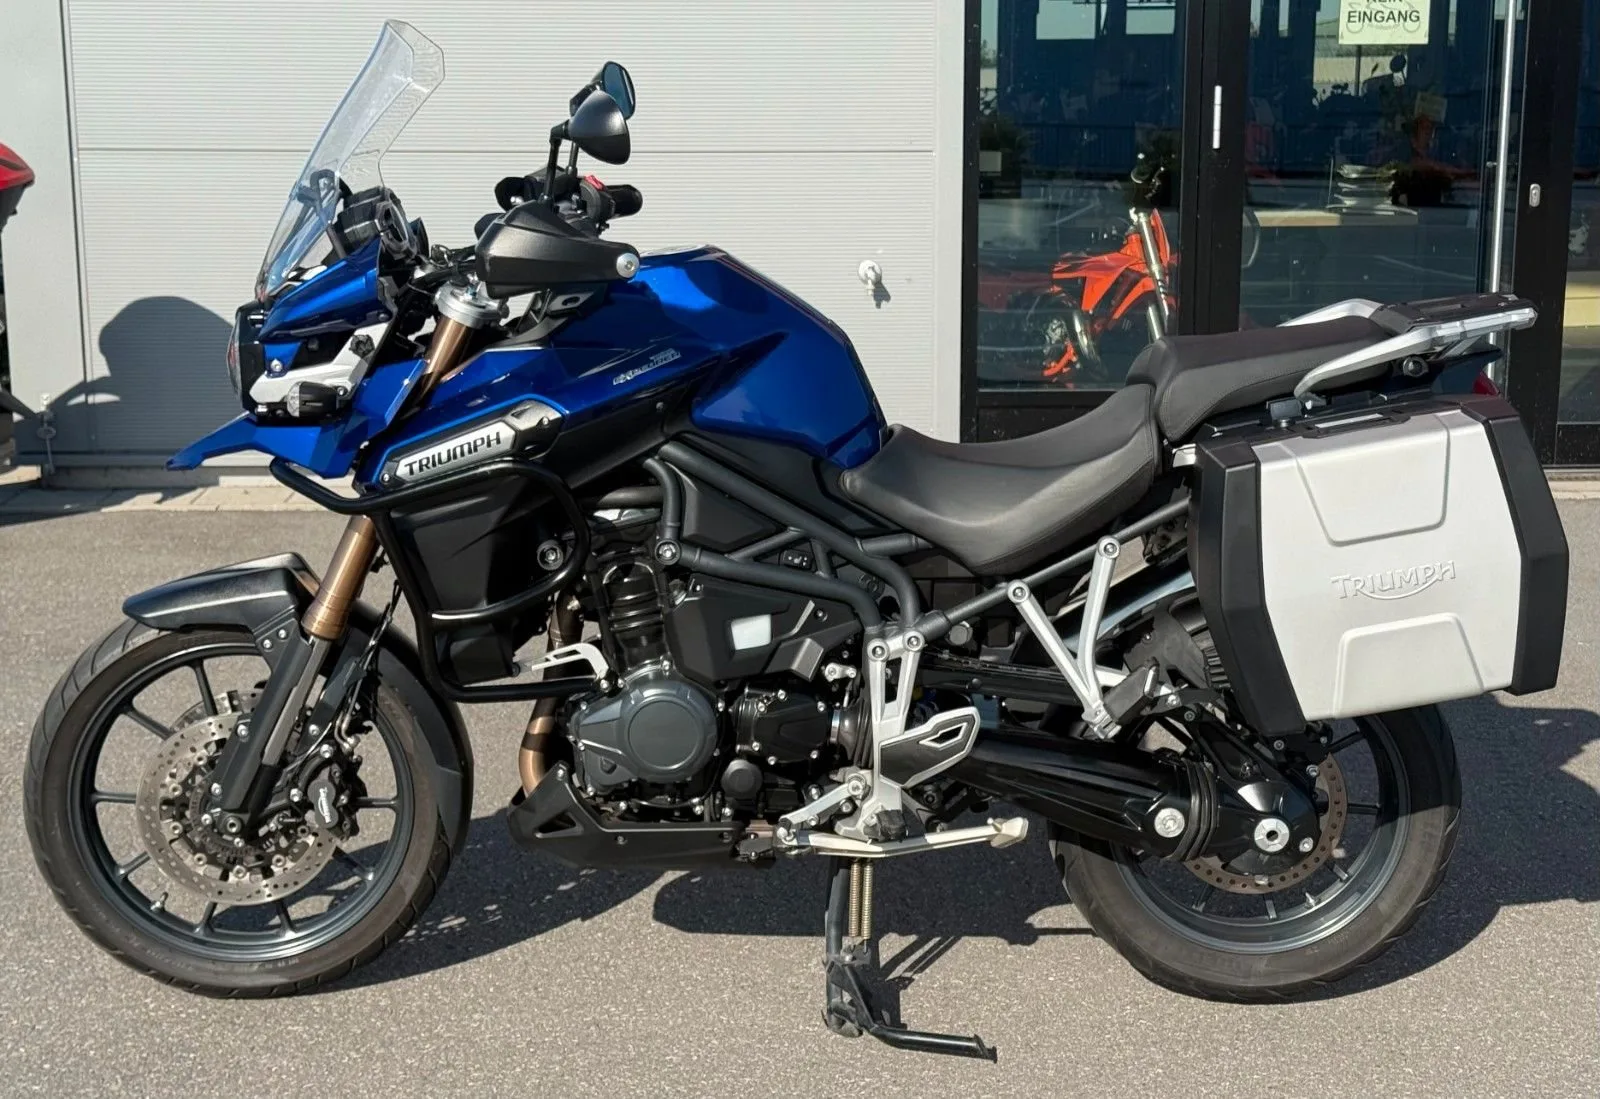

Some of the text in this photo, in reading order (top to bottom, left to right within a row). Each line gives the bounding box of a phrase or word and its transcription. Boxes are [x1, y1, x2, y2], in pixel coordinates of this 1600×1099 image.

[1347, 10, 1420, 23] EINGANG
[404, 431, 501, 476] TRIUMPH
[1330, 560, 1457, 600] TRIUMPH
